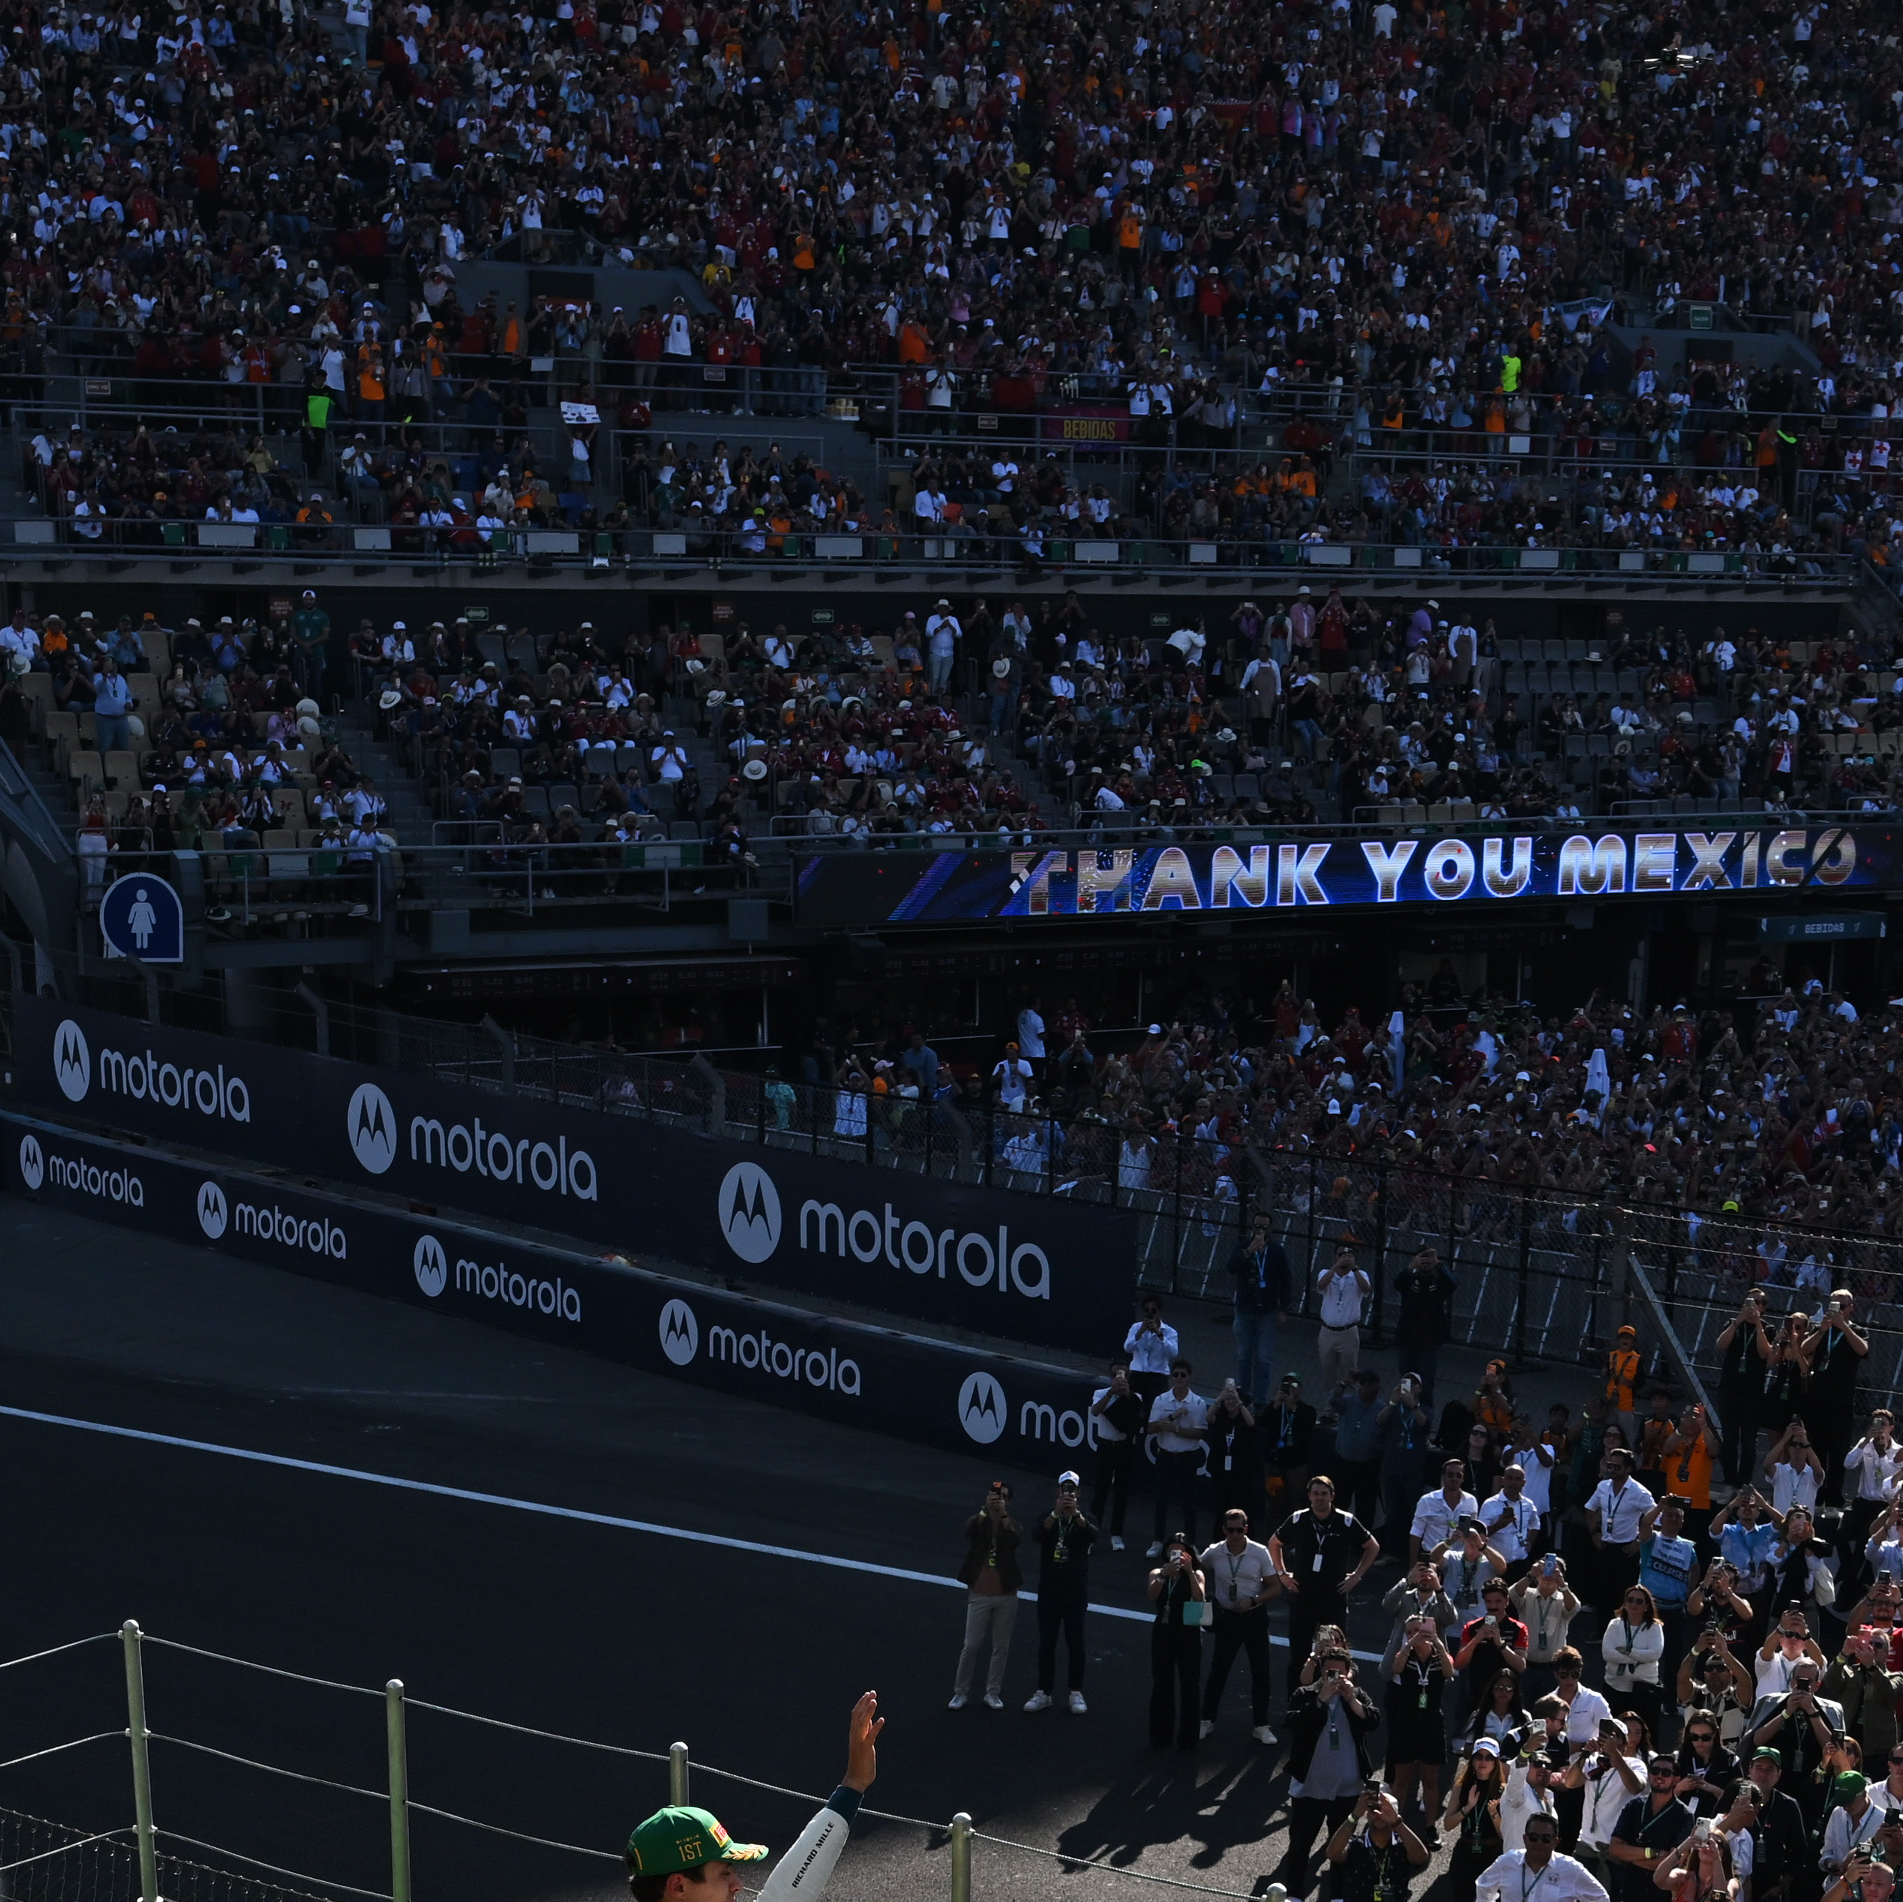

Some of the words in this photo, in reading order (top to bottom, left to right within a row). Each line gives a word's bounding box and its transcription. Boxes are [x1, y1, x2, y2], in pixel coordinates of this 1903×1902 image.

[1063, 419, 1116, 440] BEBIDAS
[1010, 844, 1331, 915] THANK
[1360, 836, 1535, 903] YOU
[1557, 828, 1856, 895] MEXICO
[1805, 922, 1844, 934] BEBIDAS
[99, 1047, 250, 1123] motorola
[50, 1155, 144, 1207] motorola
[410, 1115, 598, 1201] motorola
[235, 1202, 346, 1260] motorola
[800, 1197, 1051, 1301] motorola
[456, 1258, 581, 1322] motorola
[708, 1325, 861, 1396] motorola
[792, 1848, 818, 1889] RICHARD
[815, 1821, 835, 1849] MILLE
